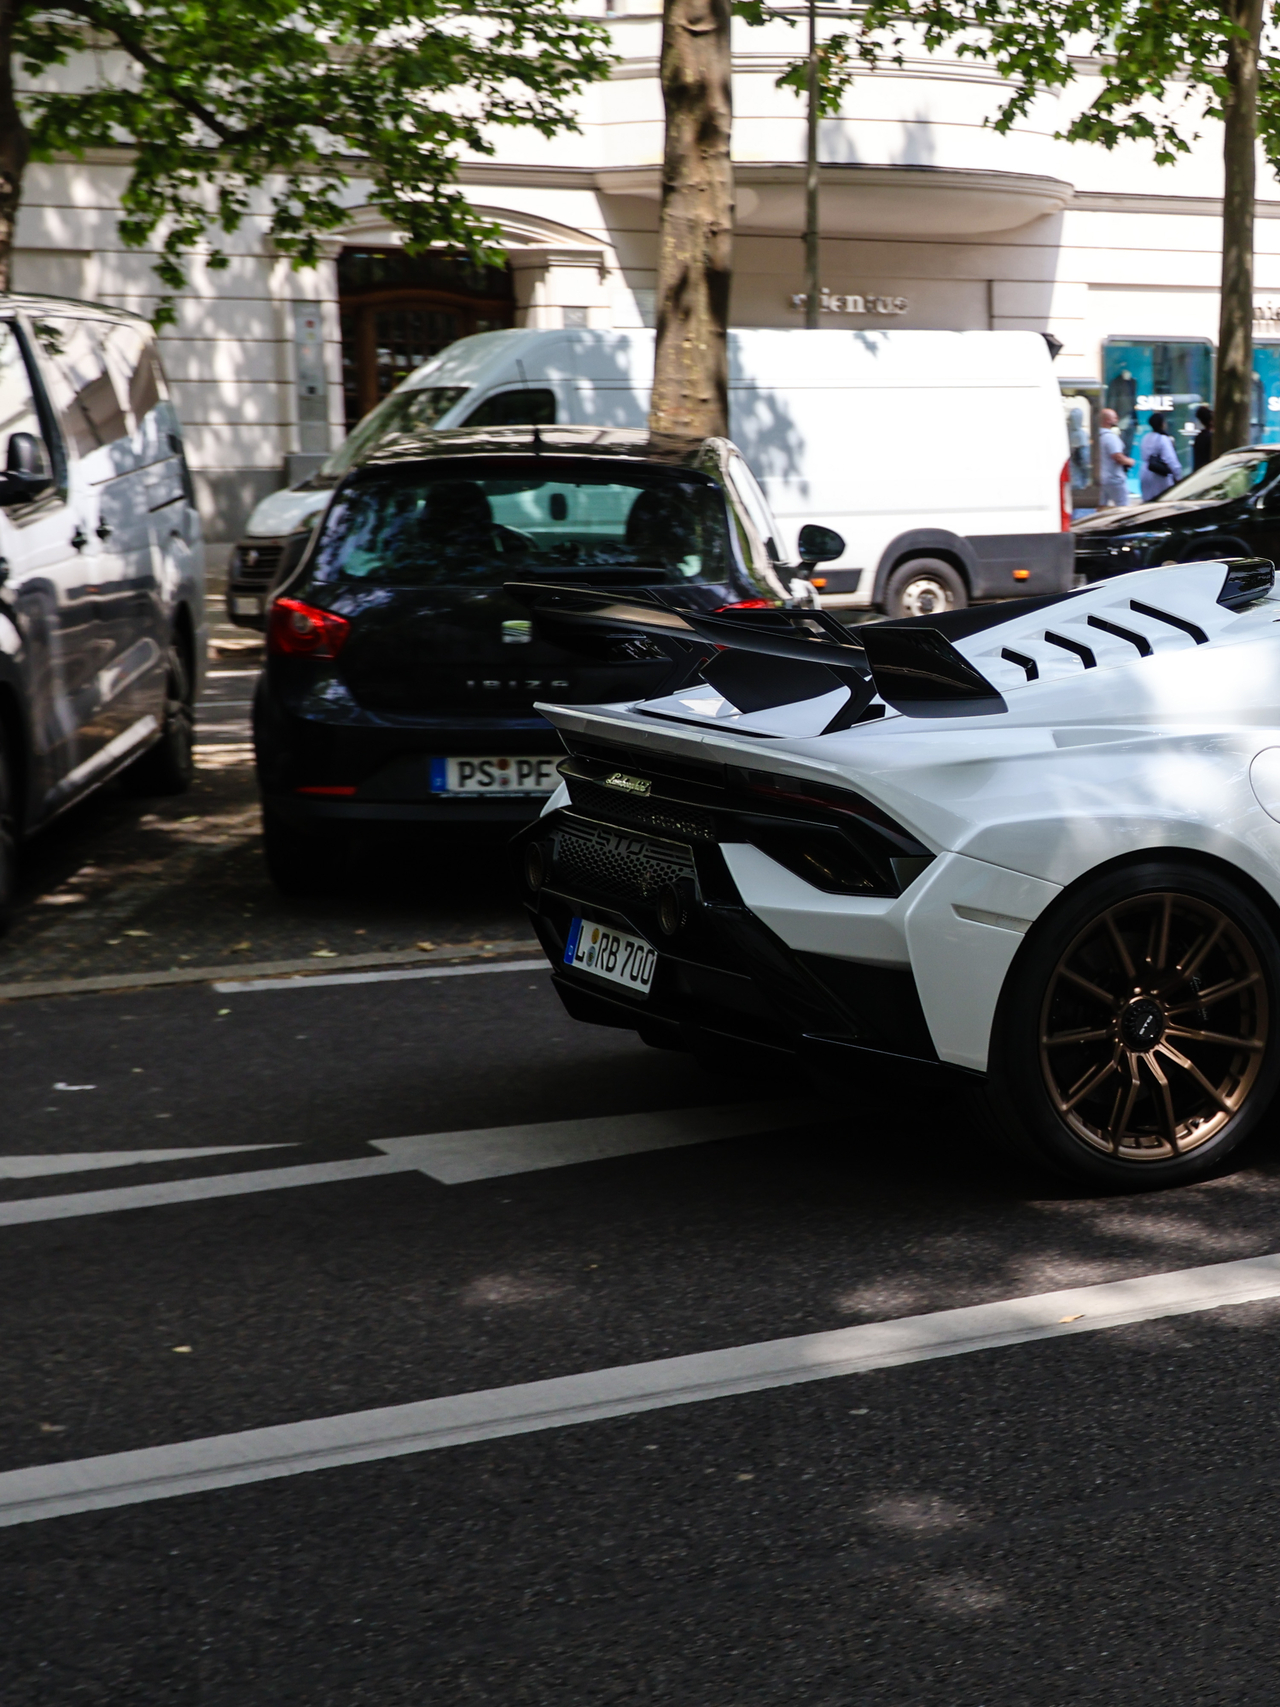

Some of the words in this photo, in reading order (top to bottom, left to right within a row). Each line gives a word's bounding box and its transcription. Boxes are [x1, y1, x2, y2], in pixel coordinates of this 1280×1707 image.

[1136, 395, 1174, 411] SALE
[466, 680, 569, 690] IBIZA
[457, 760, 495, 788] PS
[516, 760, 553, 787] PF
[595, 830, 645, 855] STO
[575, 925, 586, 963] L
[595, 932, 621, 973] RB
[620, 940, 656, 986] 700
